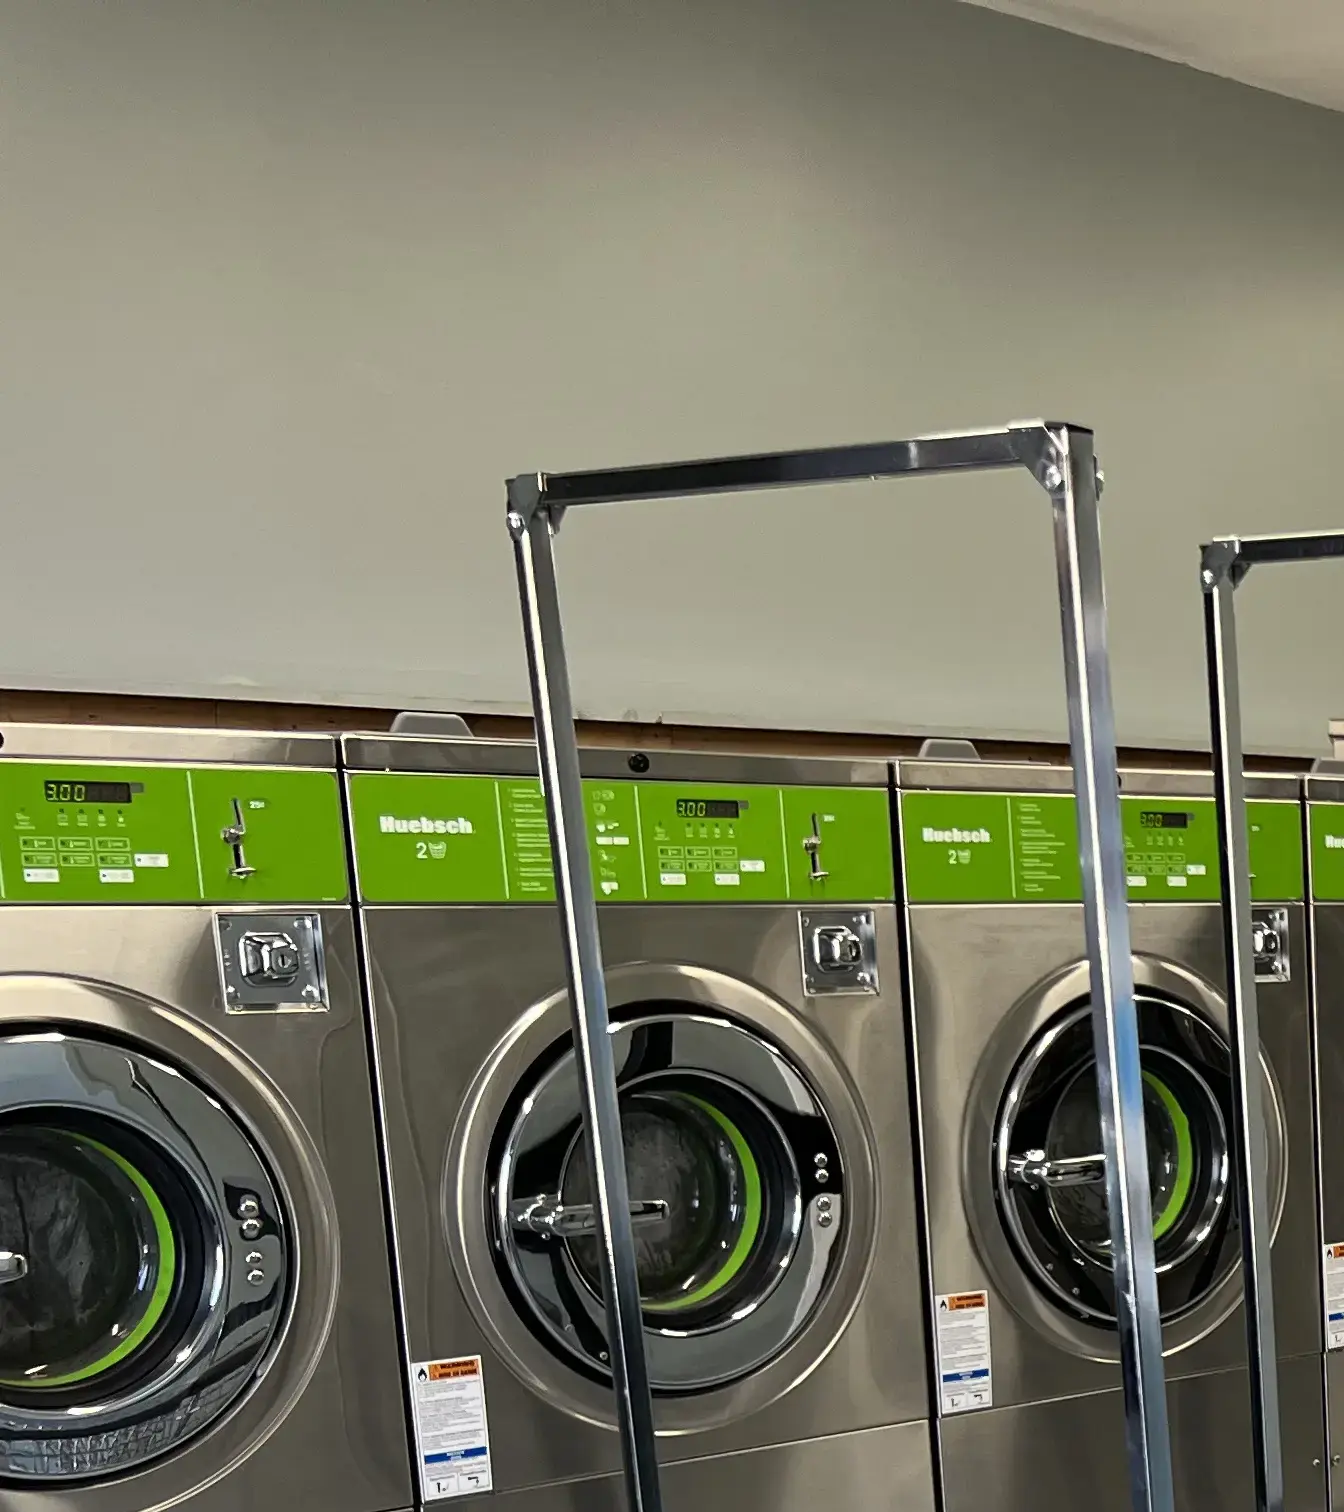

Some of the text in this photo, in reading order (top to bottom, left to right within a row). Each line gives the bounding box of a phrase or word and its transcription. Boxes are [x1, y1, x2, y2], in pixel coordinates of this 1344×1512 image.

[47, 784, 86, 801] 3.00
[379, 815, 473, 834] Huebsch
[922, 827, 990, 843] Huebsch
[415, 842, 428, 859] 2
[947, 849, 957, 865] 2
